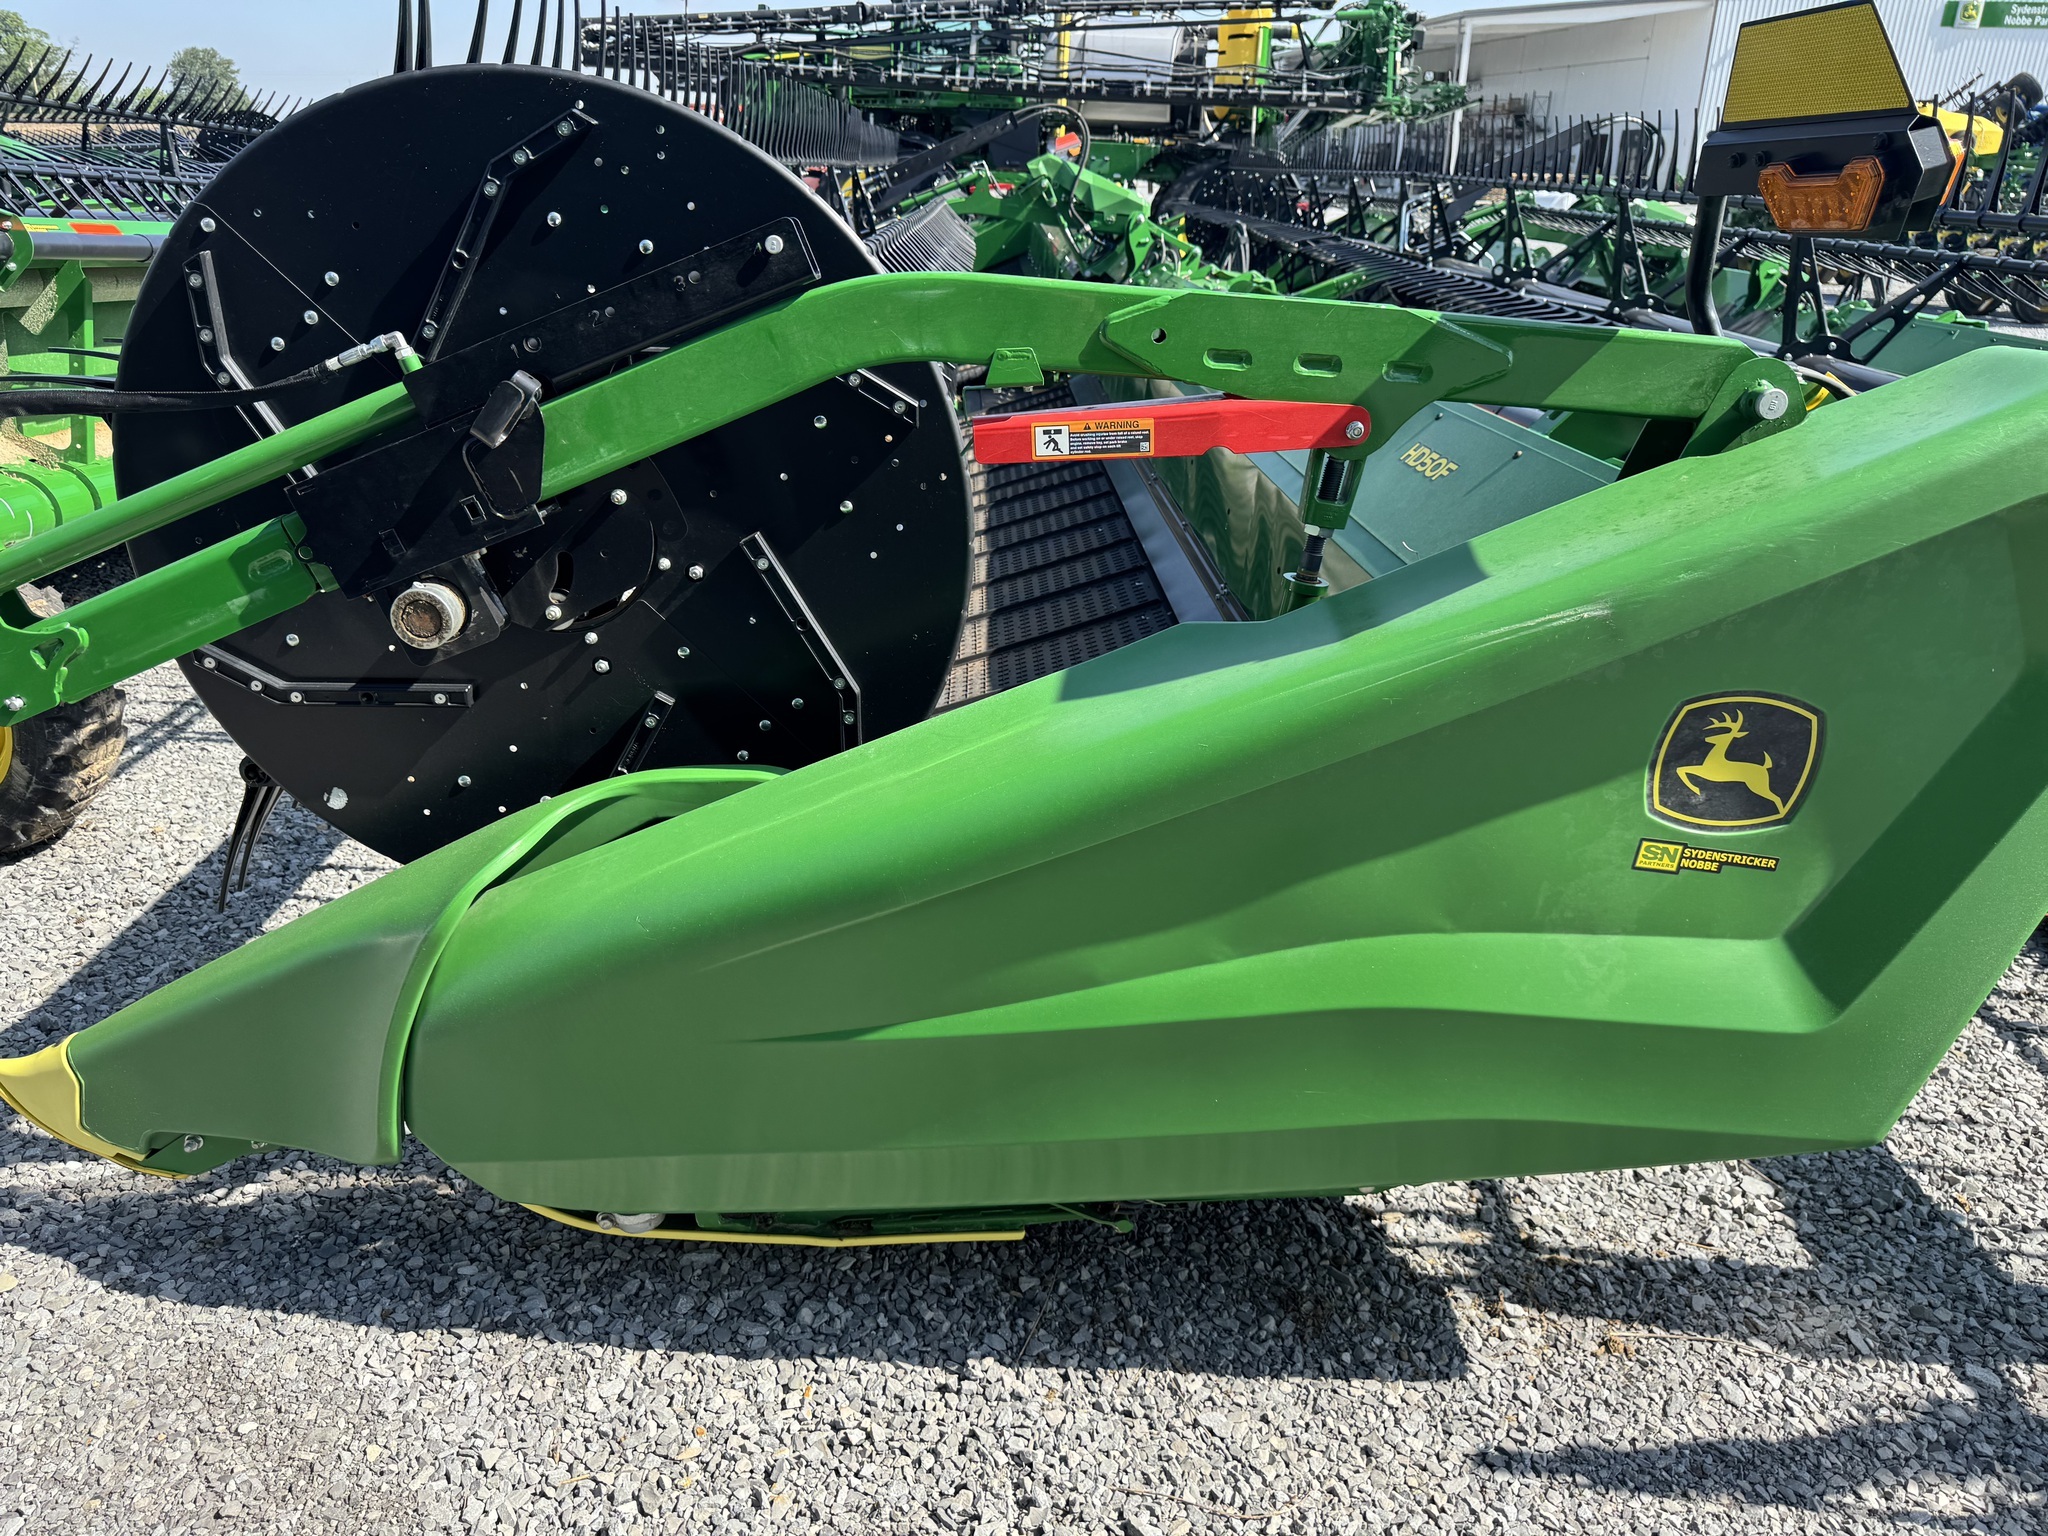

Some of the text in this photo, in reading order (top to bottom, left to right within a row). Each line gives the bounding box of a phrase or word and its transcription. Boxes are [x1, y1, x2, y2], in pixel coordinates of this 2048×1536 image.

[2004, 15, 2033, 26] Nobbe
[1095, 420, 1140, 430] WARNING
[1400, 442, 1459, 481] HD50F
[1641, 844, 1679, 863] SN
[1683, 848, 1776, 869] SYDENSTRICKER
[1639, 860, 1675, 869] PARTNERS
[1680, 858, 1720, 872] NOBBE
